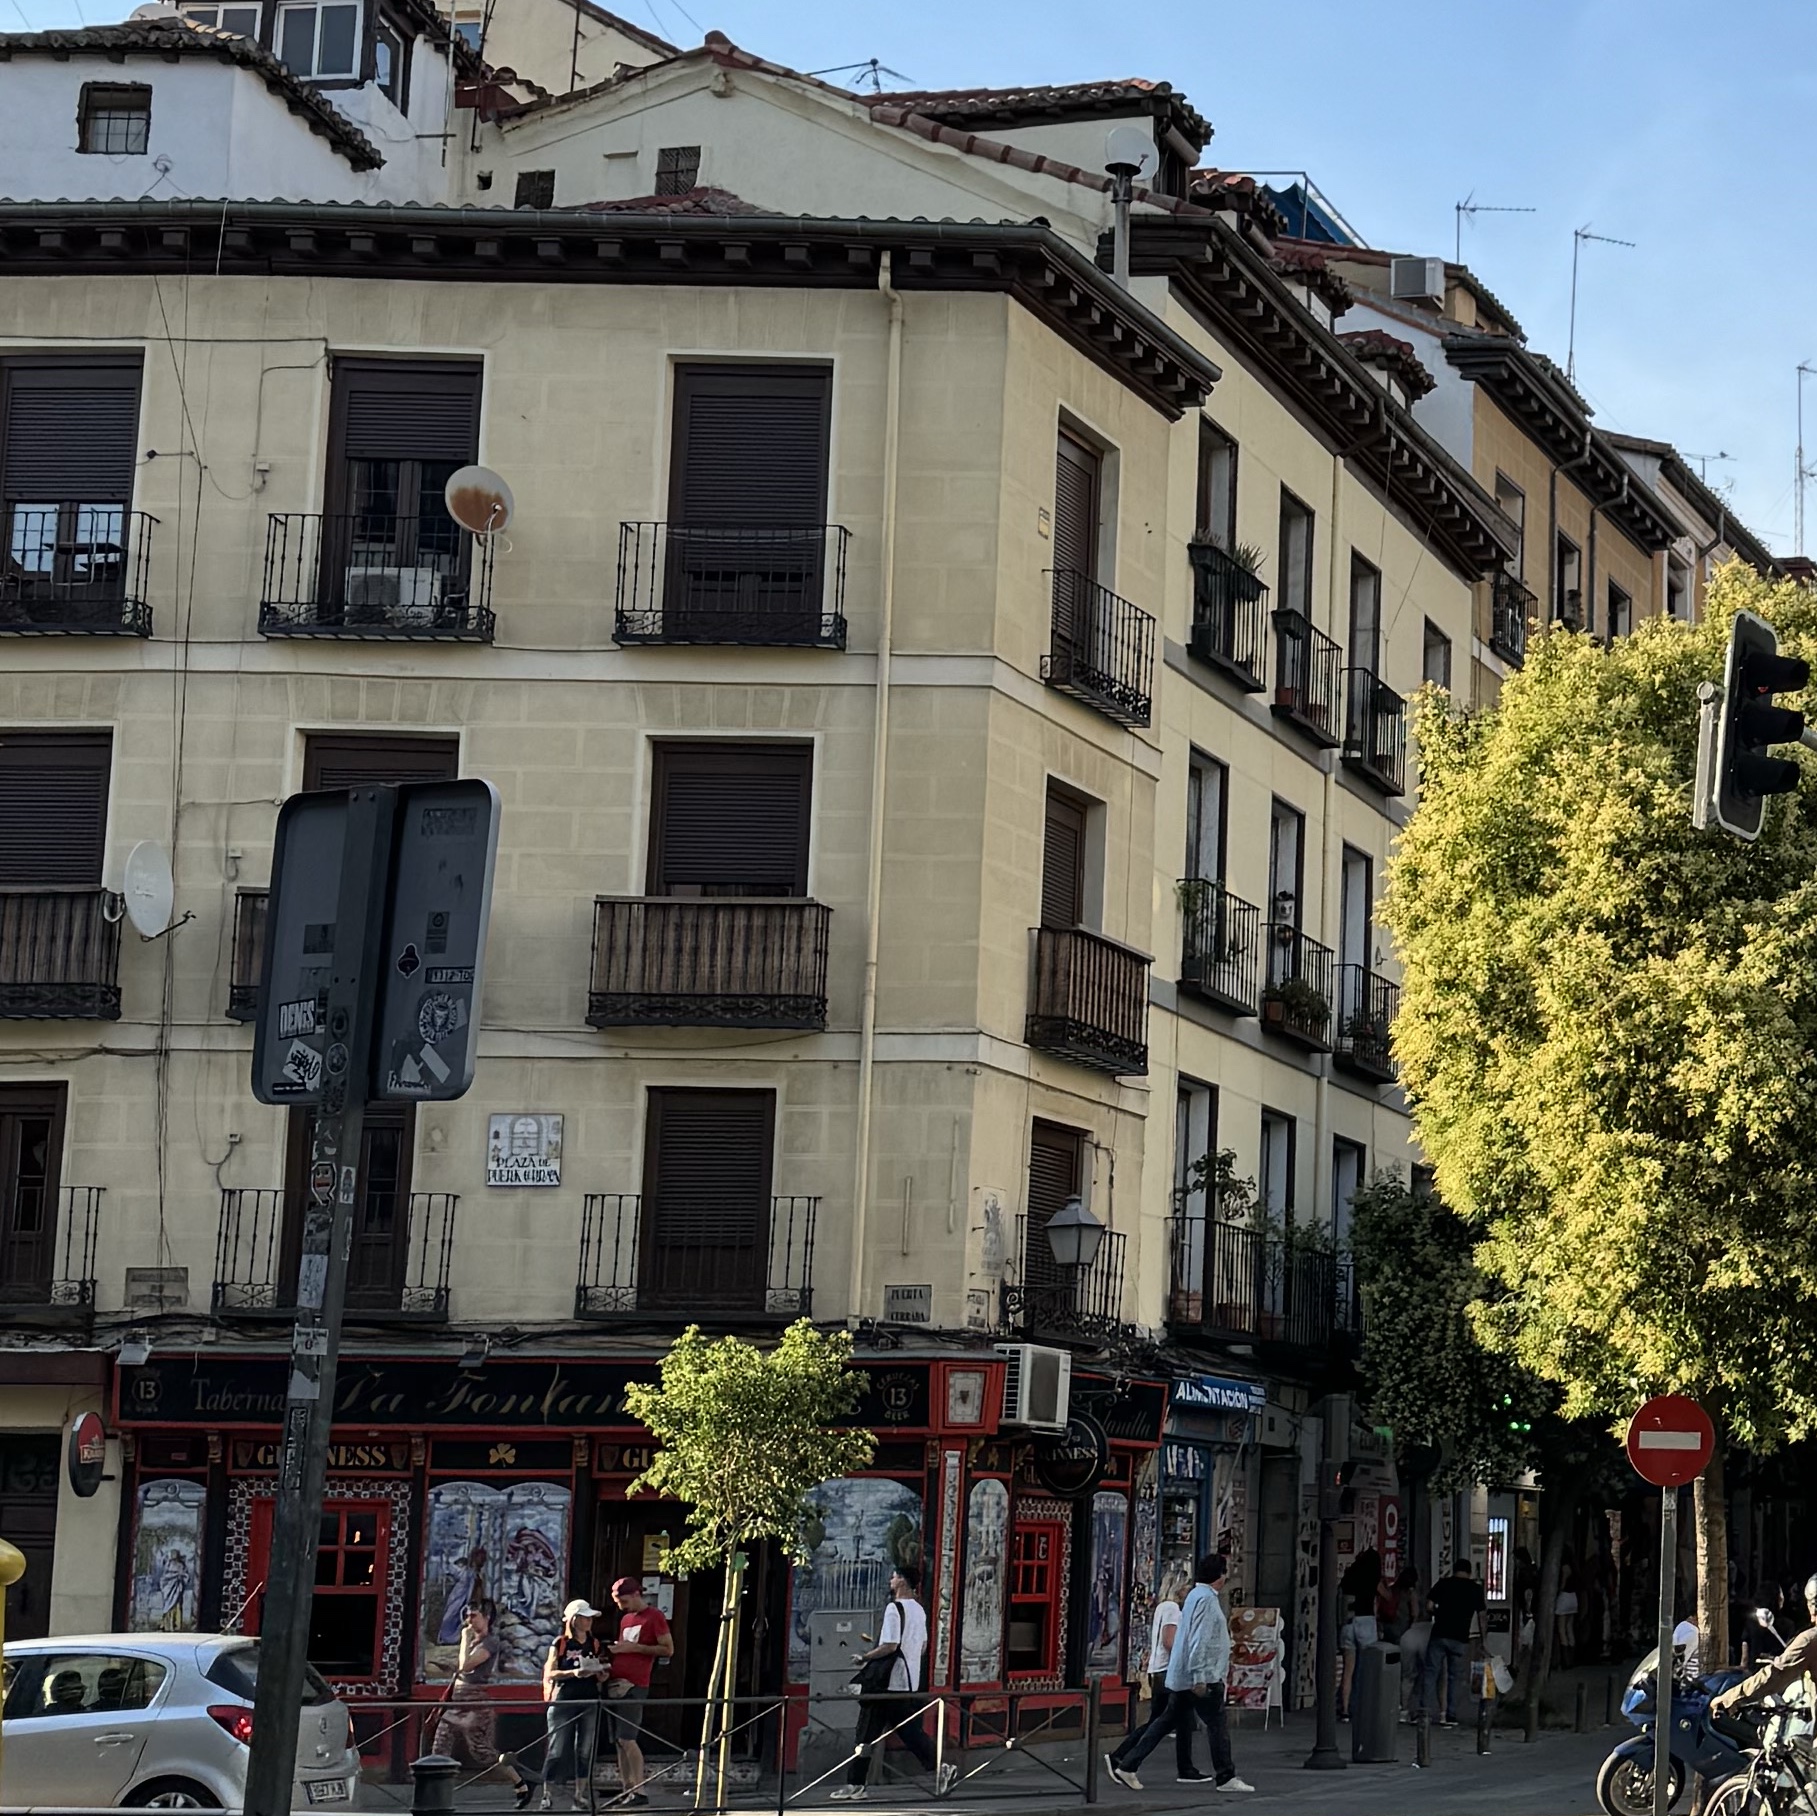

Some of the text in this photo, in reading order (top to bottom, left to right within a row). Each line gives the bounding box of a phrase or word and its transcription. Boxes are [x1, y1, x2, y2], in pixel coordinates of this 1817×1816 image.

[139, 1381, 156, 1400] 13
[190, 1378, 287, 1412] Taberna
[889, 1387, 907, 1406] 13
[257, 1445, 386, 1467] GNESS
